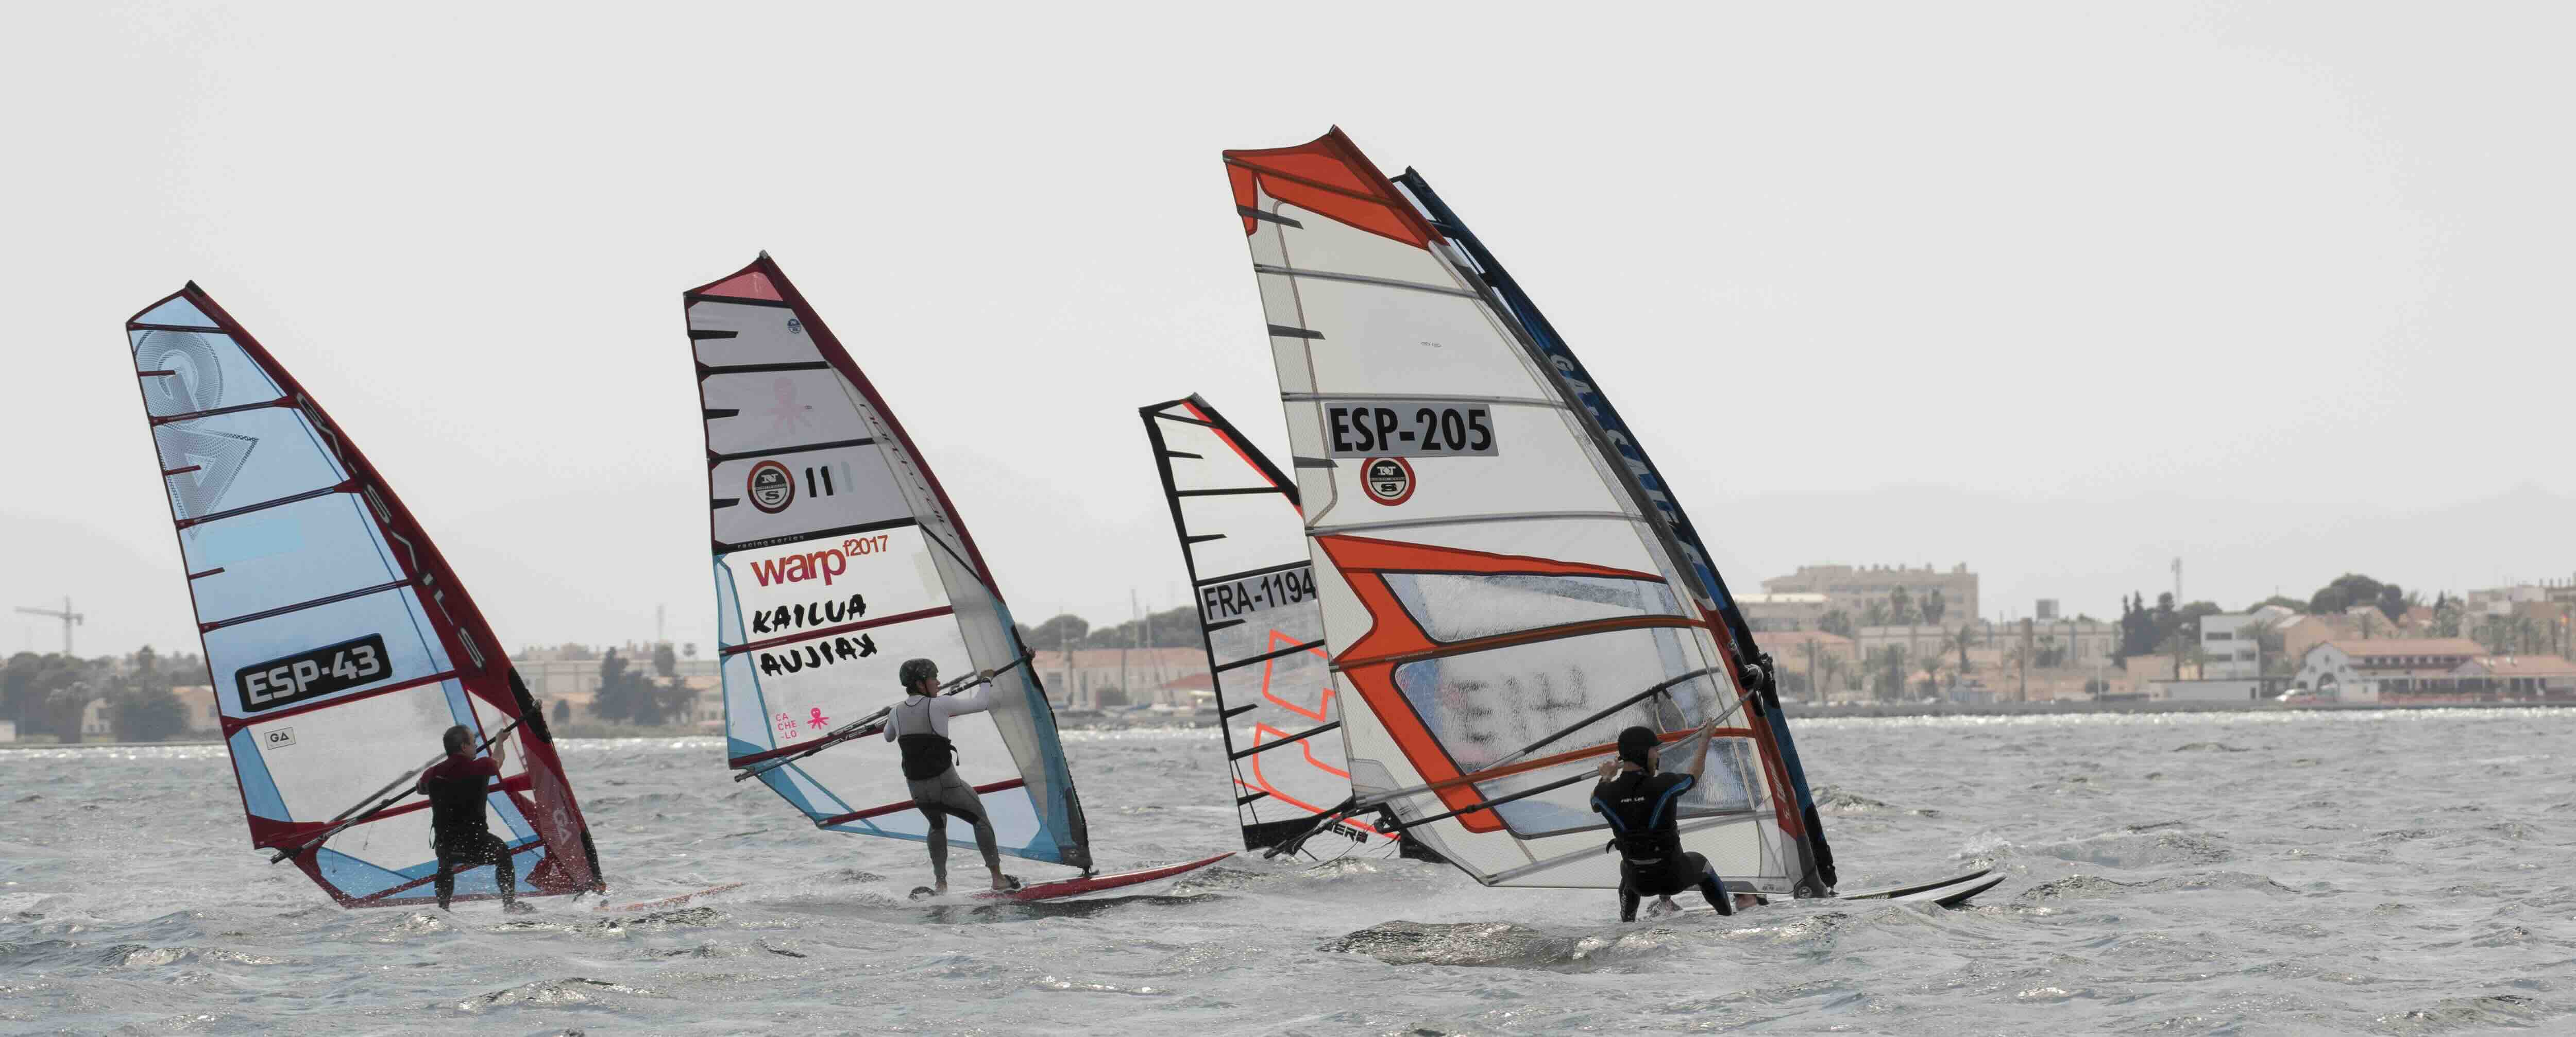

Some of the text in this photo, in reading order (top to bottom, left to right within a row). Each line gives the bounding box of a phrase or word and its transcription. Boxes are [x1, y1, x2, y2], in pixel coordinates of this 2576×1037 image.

[1329, 407, 1492, 452] ESP-205
[750, 534, 888, 587] warp f2017
[753, 593, 867, 634] KAILUA
[1203, 568, 1317, 620] FRA-1194
[244, 645, 380, 705] ESP-43
[777, 720, 797, 730] CHE
